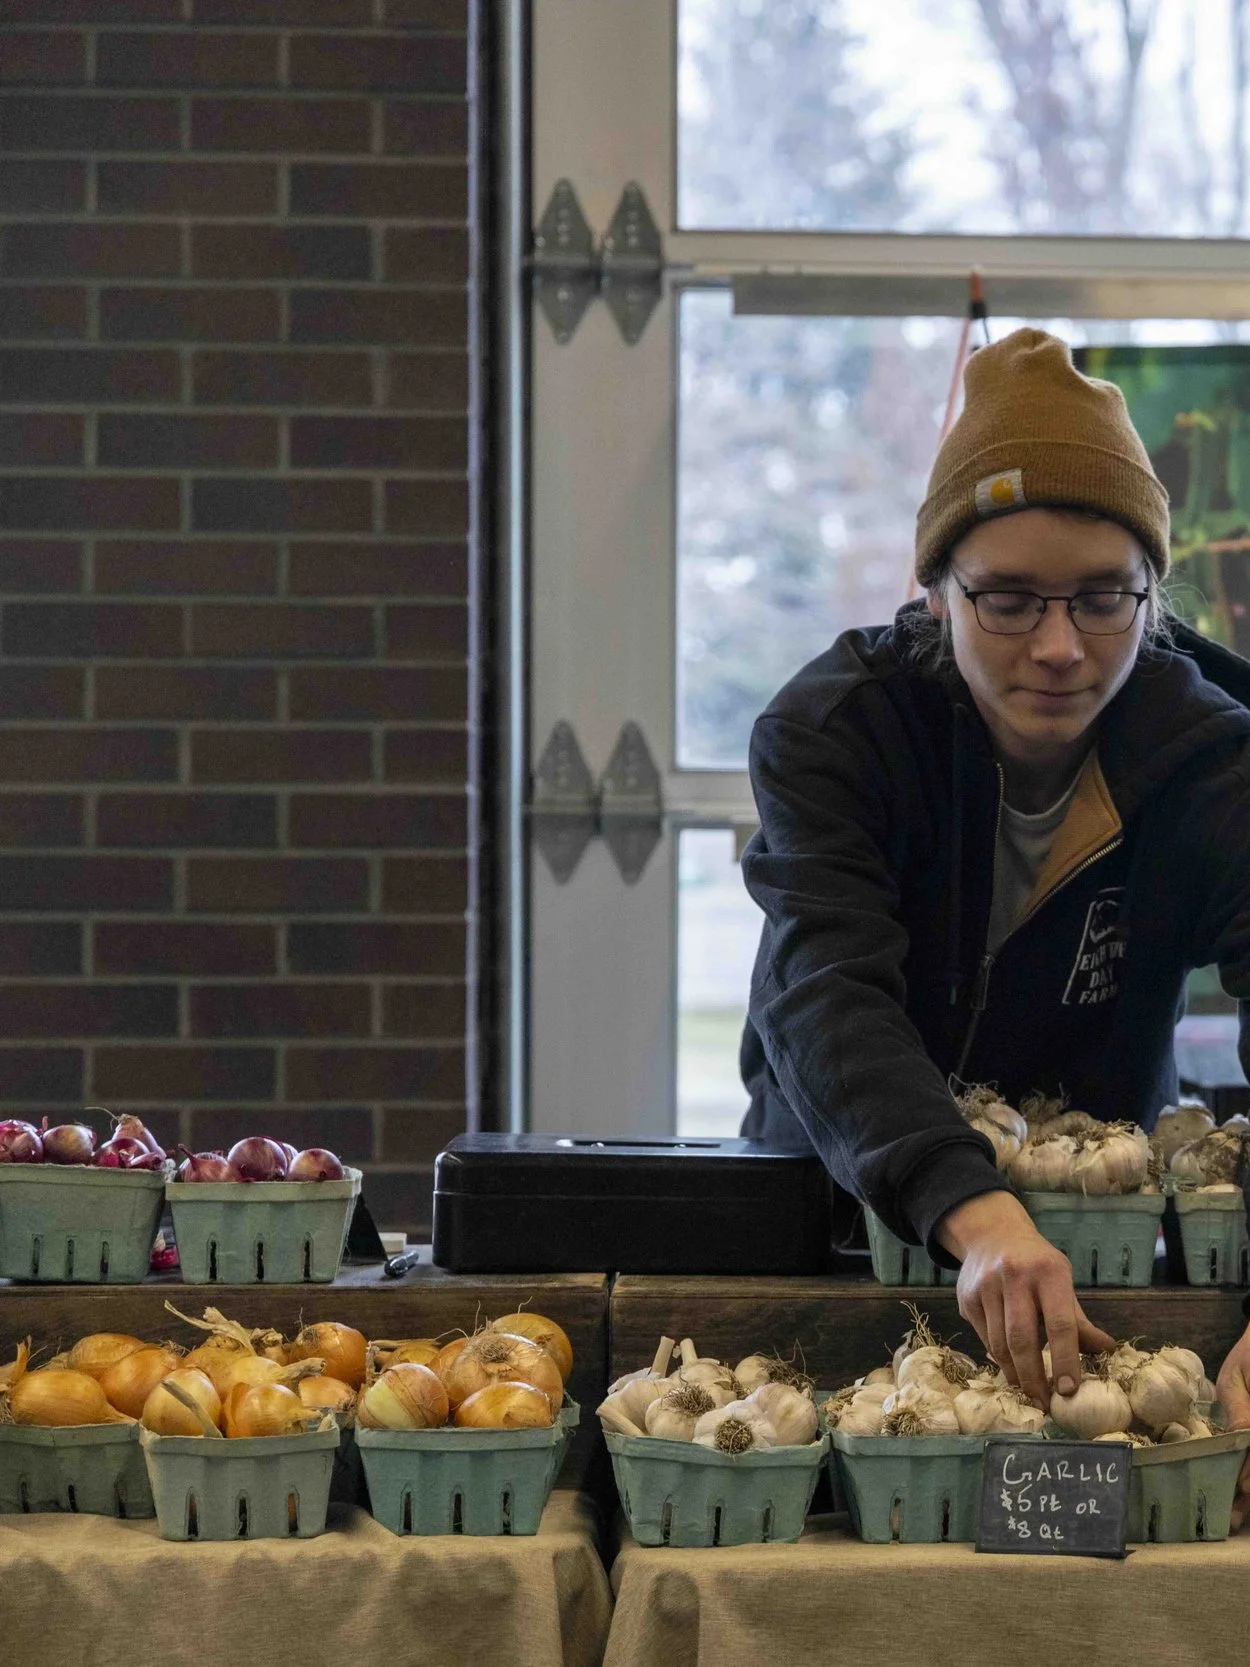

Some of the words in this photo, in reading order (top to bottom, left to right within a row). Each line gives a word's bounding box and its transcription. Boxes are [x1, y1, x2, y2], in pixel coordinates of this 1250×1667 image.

[1089, 964, 1114, 988] DAY
[1002, 1453, 1119, 1485] GARLIC
[1000, 1484, 1032, 1512] $5
[1008, 1515, 1031, 1538] $8
